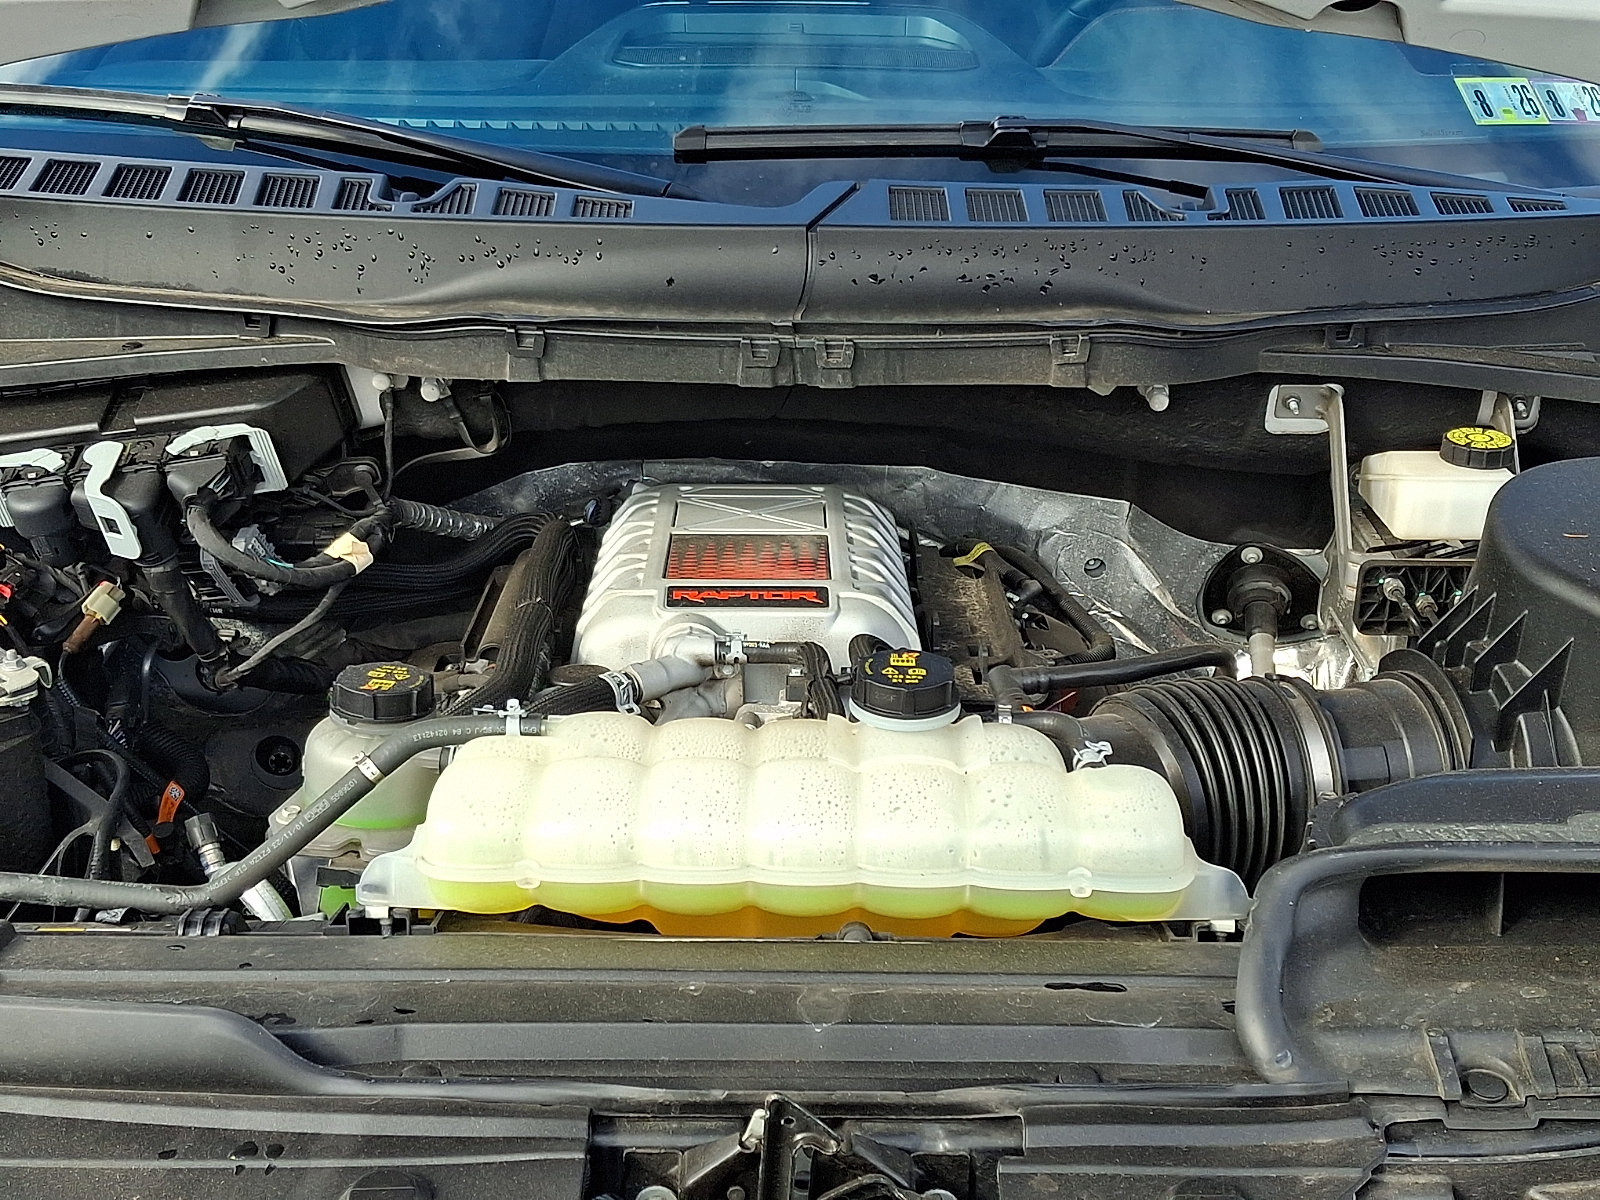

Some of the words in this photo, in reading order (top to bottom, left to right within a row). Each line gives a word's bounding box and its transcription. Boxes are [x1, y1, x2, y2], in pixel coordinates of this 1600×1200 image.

[1473, 89, 1494, 118] 8
[1511, 84, 1541, 116] 26
[1545, 89, 1566, 118] 8
[672, 590, 824, 604] RAPTOR
